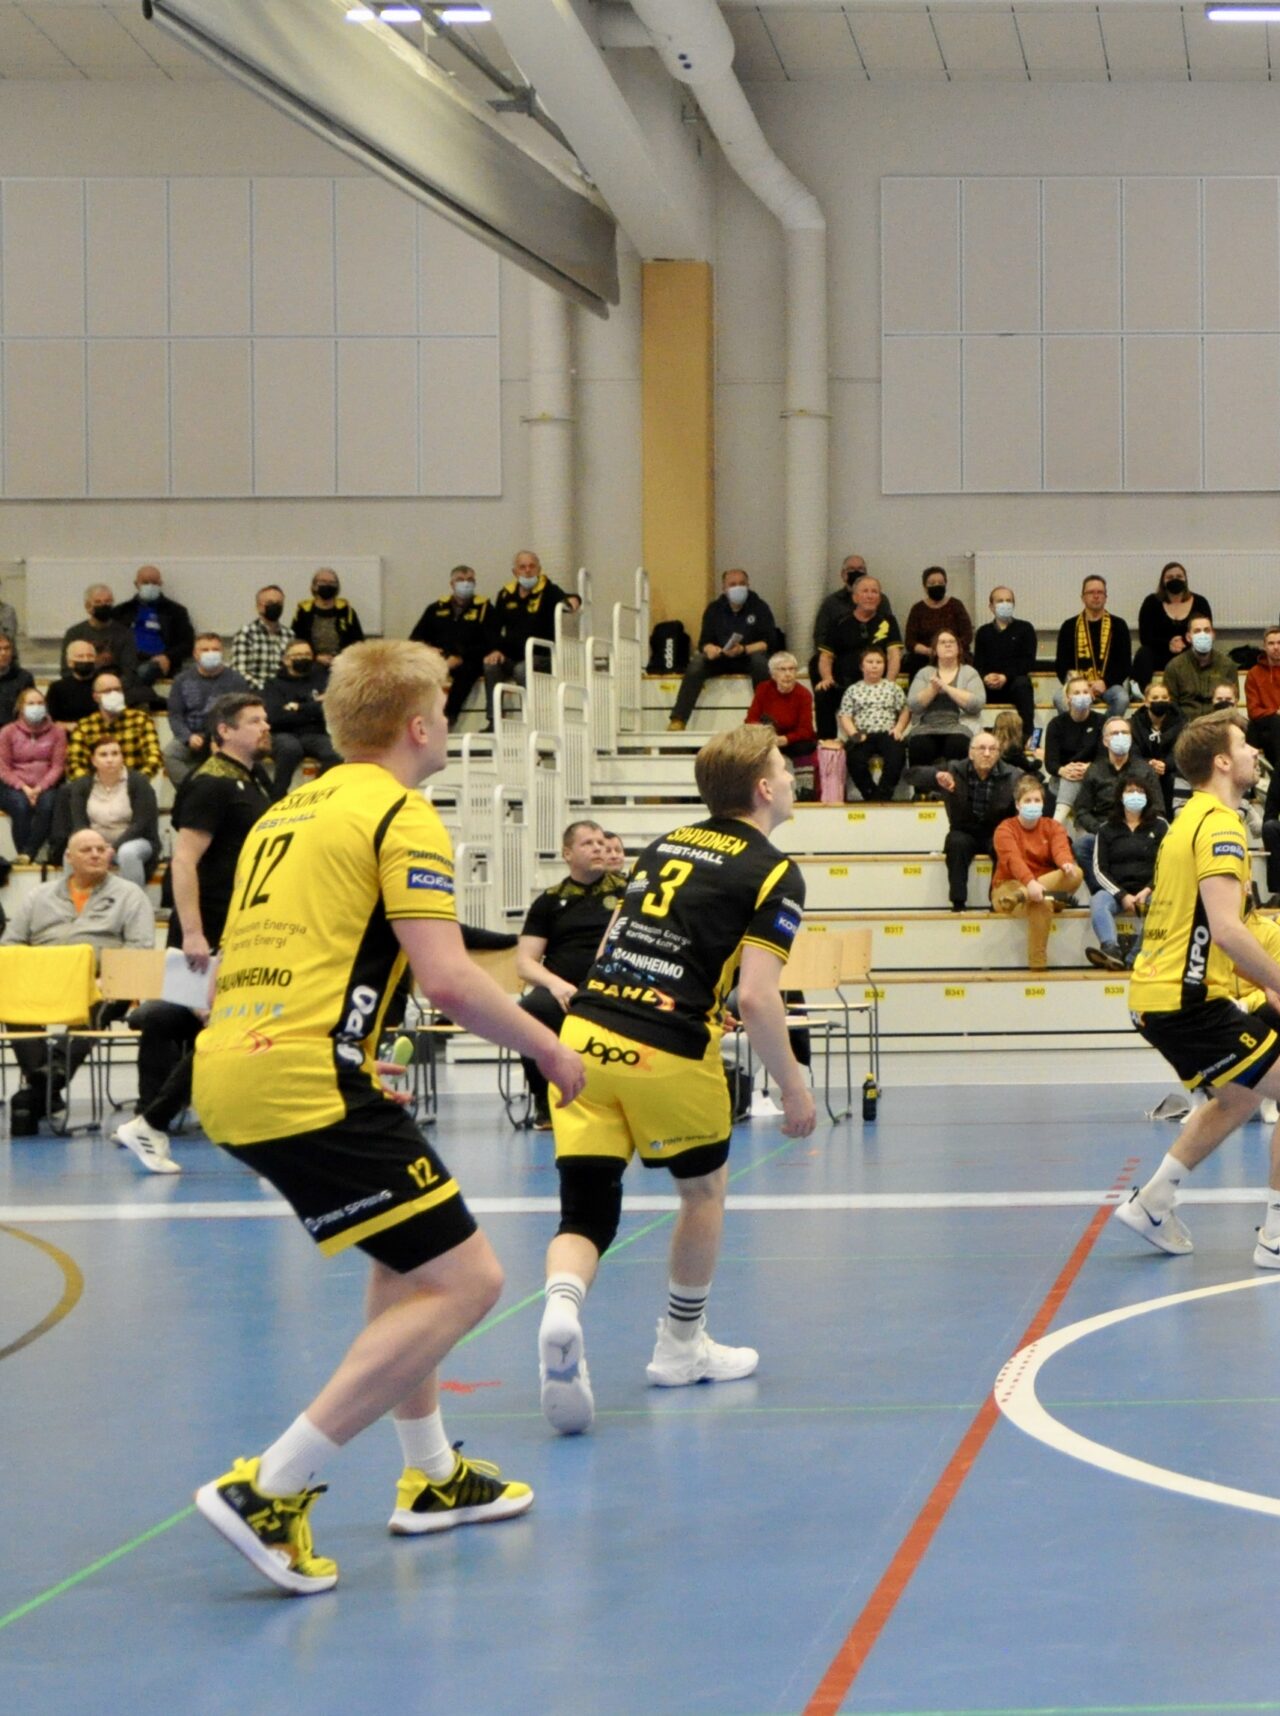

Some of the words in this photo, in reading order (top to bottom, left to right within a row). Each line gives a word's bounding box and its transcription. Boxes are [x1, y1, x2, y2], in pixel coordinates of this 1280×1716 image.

[656, 842, 725, 866] BEST-HALL
[667, 826, 747, 856] SIHVONEN
[239, 831, 295, 911] 12
[641, 858, 693, 918] 3
[1240, 1032, 1257, 1049] 8
[406, 1156, 439, 1188] 12
